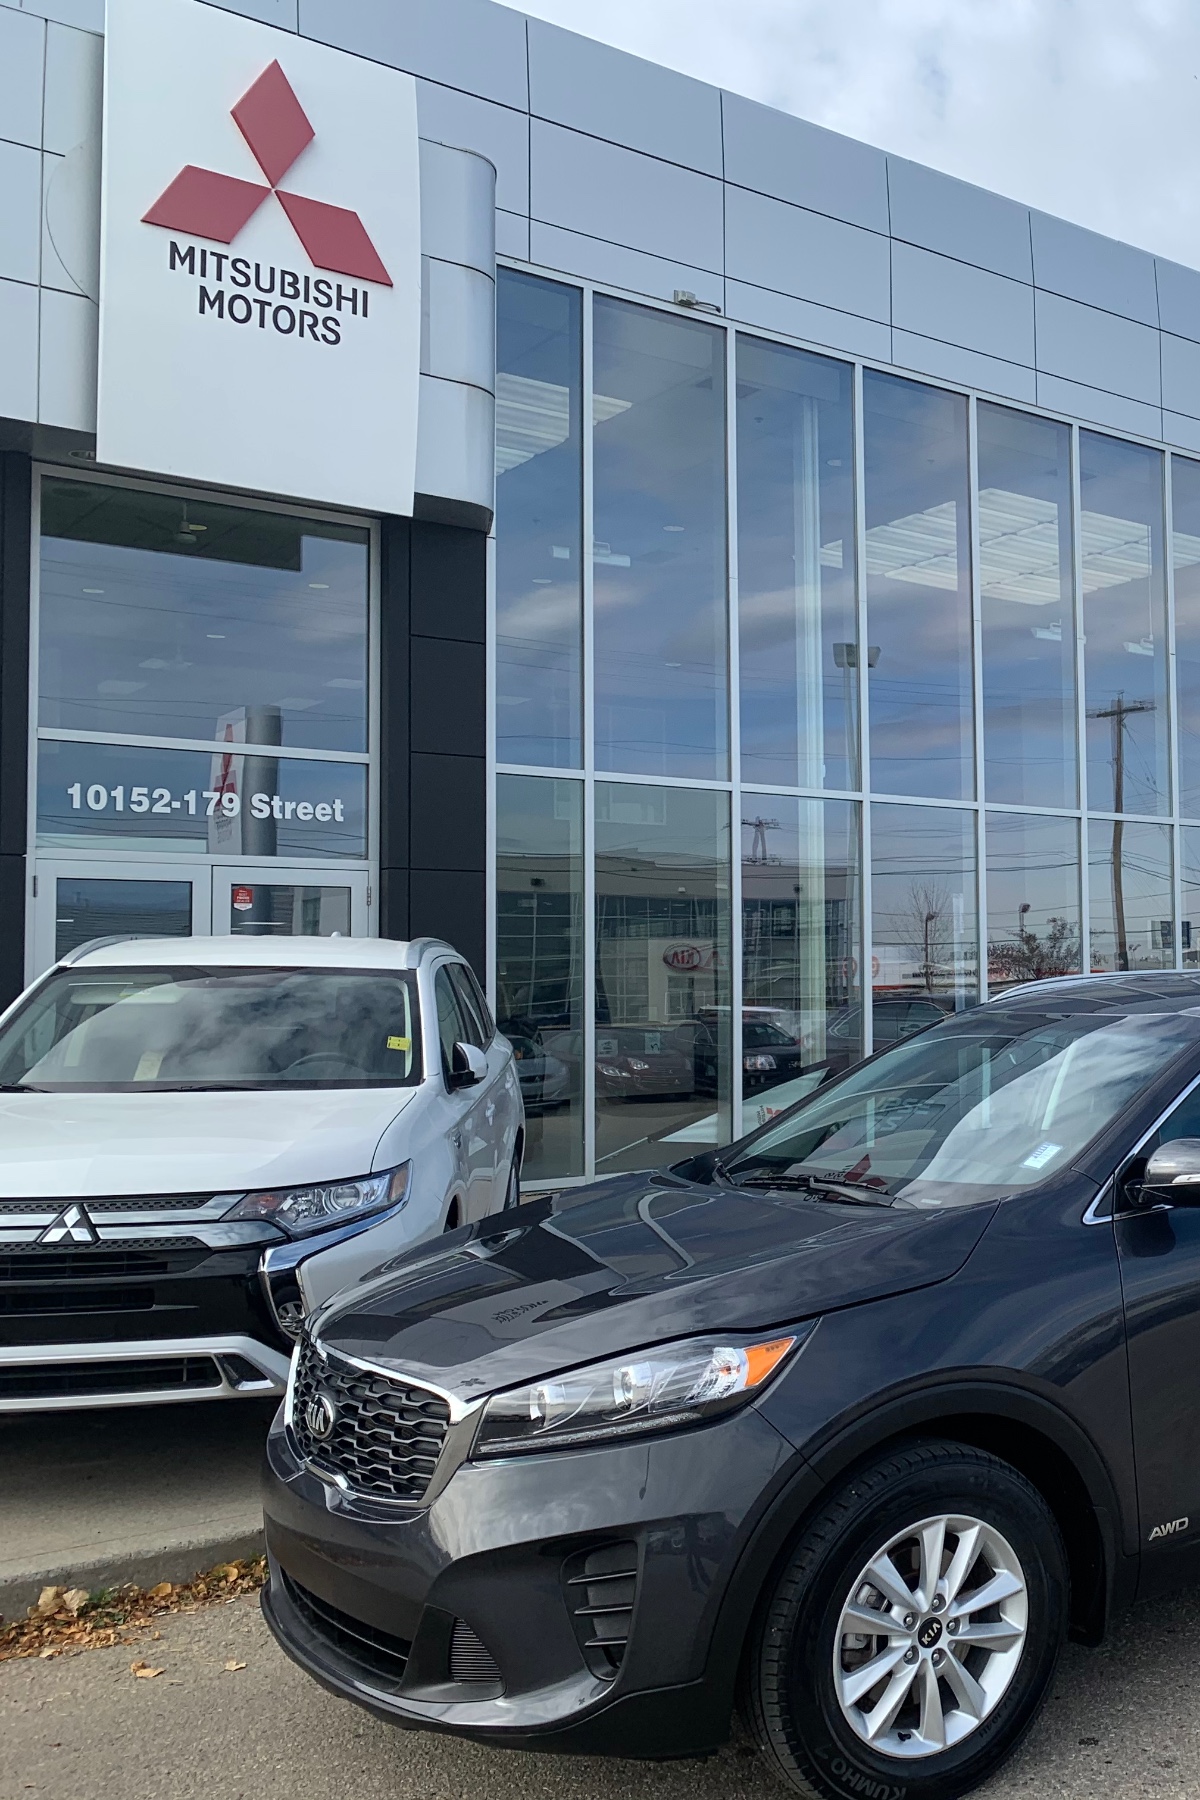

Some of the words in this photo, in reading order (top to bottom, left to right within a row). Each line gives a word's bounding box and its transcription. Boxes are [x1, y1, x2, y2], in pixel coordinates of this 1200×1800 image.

[169, 240, 369, 318] MITSUBISHI
[198, 284, 341, 346] MOTORS
[67, 782, 240, 818] 10152-179
[250, 793, 344, 822] Street
[308, 1401, 325, 1432] KIA
[1148, 1516, 1189, 1541] AWD
[921, 1622, 941, 1645] KIA
[830, 1758, 907, 1800] KUMHO
